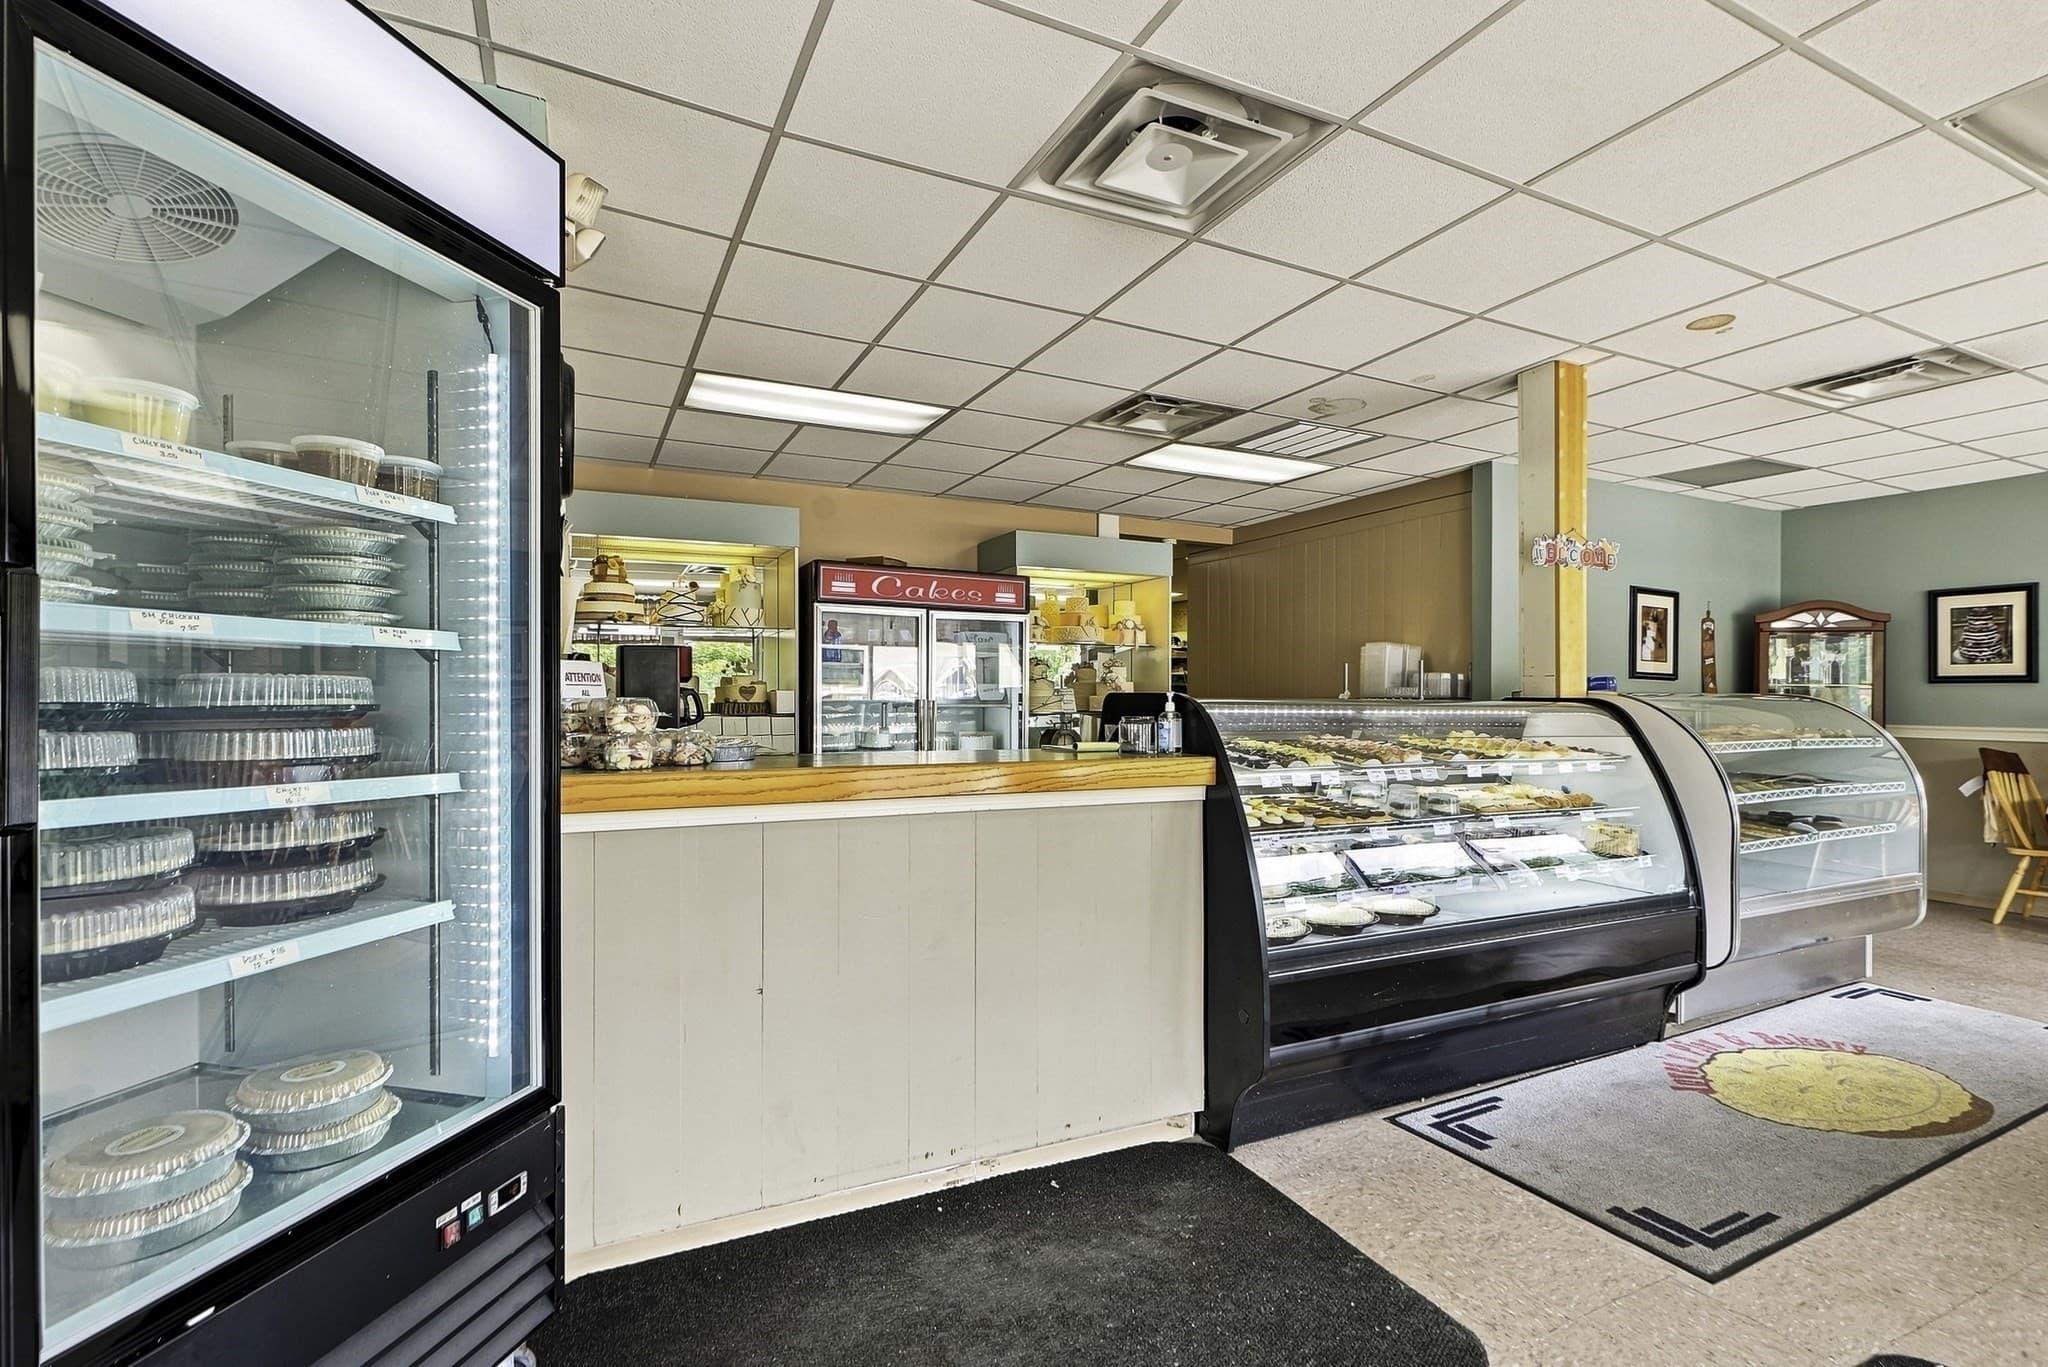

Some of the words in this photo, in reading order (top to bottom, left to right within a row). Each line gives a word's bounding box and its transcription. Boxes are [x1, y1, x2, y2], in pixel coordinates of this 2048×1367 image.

[1534, 542, 1616, 566] WELCOME
[871, 575, 983, 601] Cakes
[564, 671, 602, 683] ATTENTION
[581, 689, 591, 697] ALL
